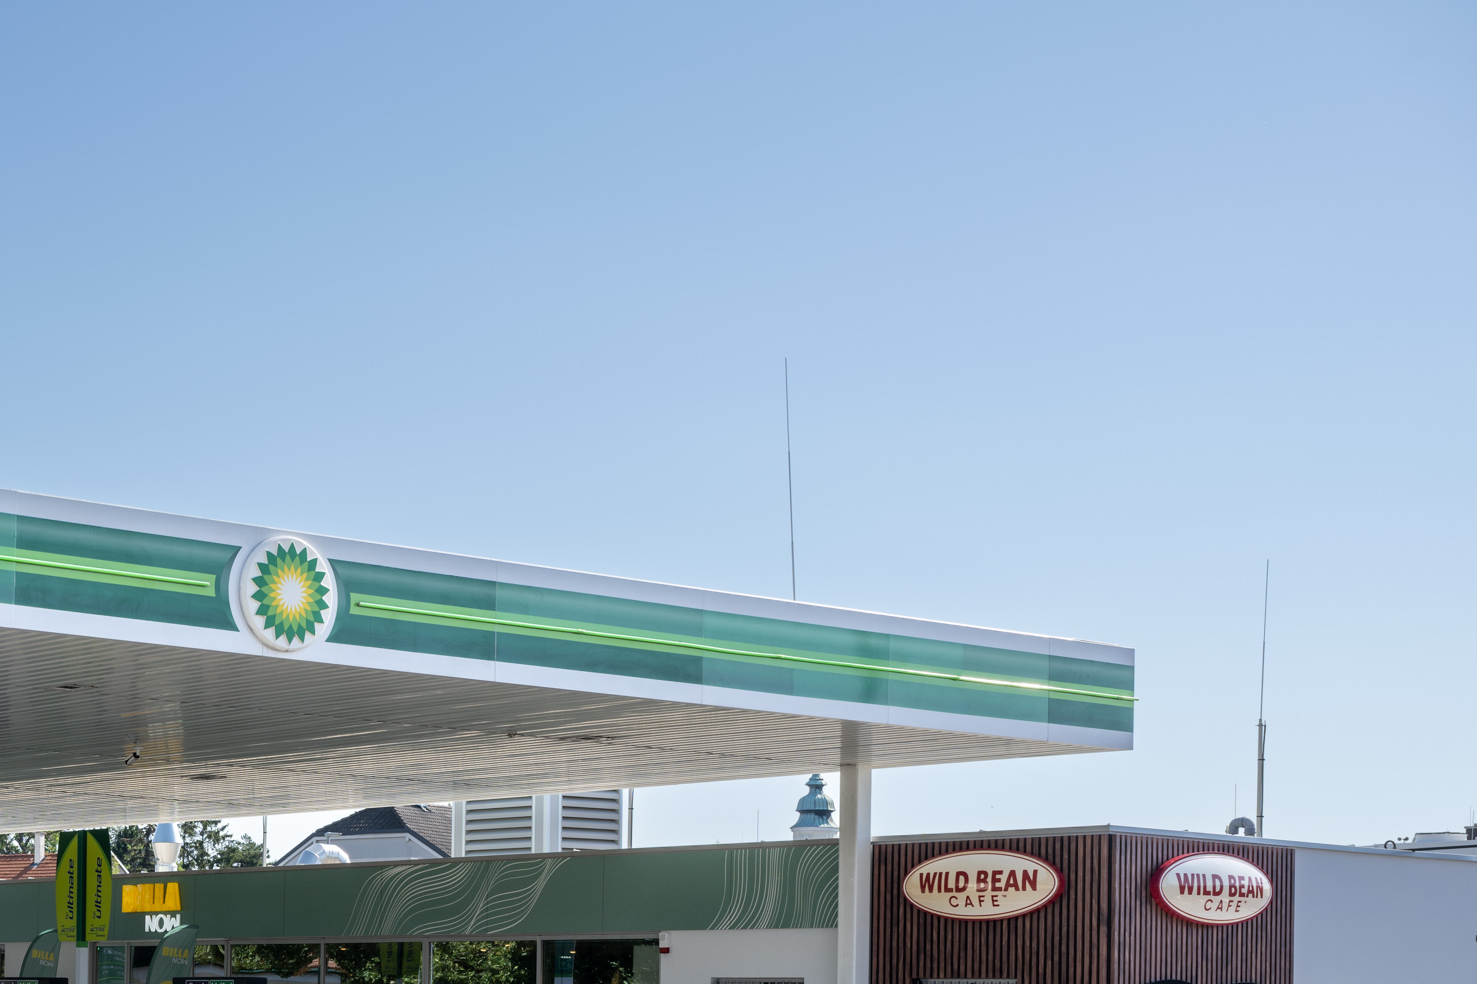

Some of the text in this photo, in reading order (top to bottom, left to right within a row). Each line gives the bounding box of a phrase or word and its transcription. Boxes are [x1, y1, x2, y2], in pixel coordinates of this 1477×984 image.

[66, 858, 75, 920] ultimate
[94, 856, 103, 919] ultimate
[919, 869, 1039, 894] WILD BEAN
[1175, 872, 1264, 899] WILD BEAN
[121, 882, 182, 913] BILLA
[144, 913, 181, 933] NOW
[31, 948, 55, 961] BILLA
[161, 946, 189, 958] BILLA
